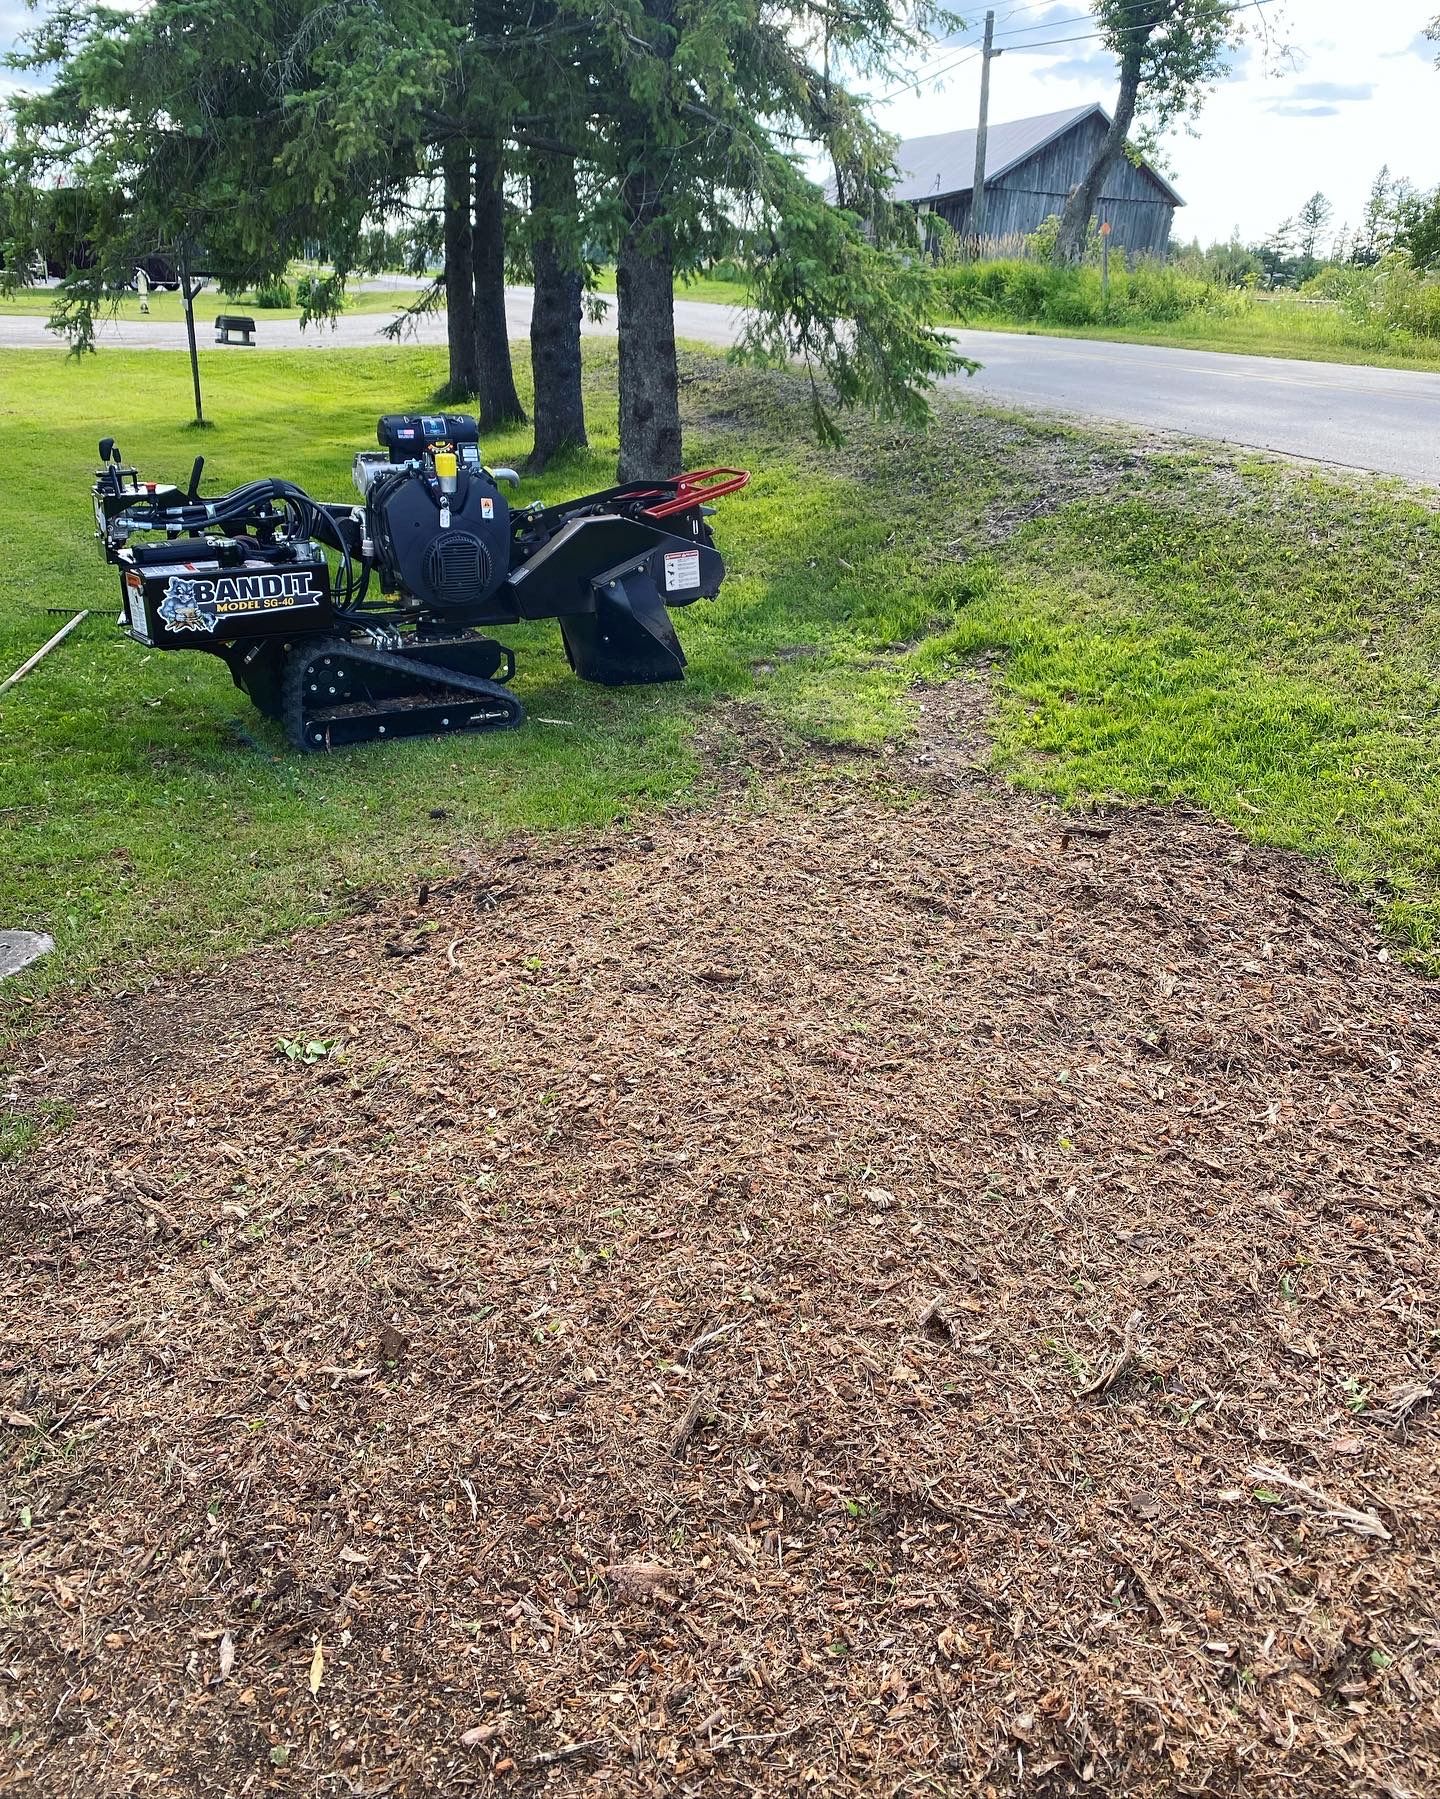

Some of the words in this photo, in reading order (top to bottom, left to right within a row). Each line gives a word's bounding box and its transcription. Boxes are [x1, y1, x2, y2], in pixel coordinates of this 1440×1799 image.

[194, 572, 312, 604] BANDIT
[216, 601, 261, 613] MODEL
[263, 597, 294, 608] SG-40
